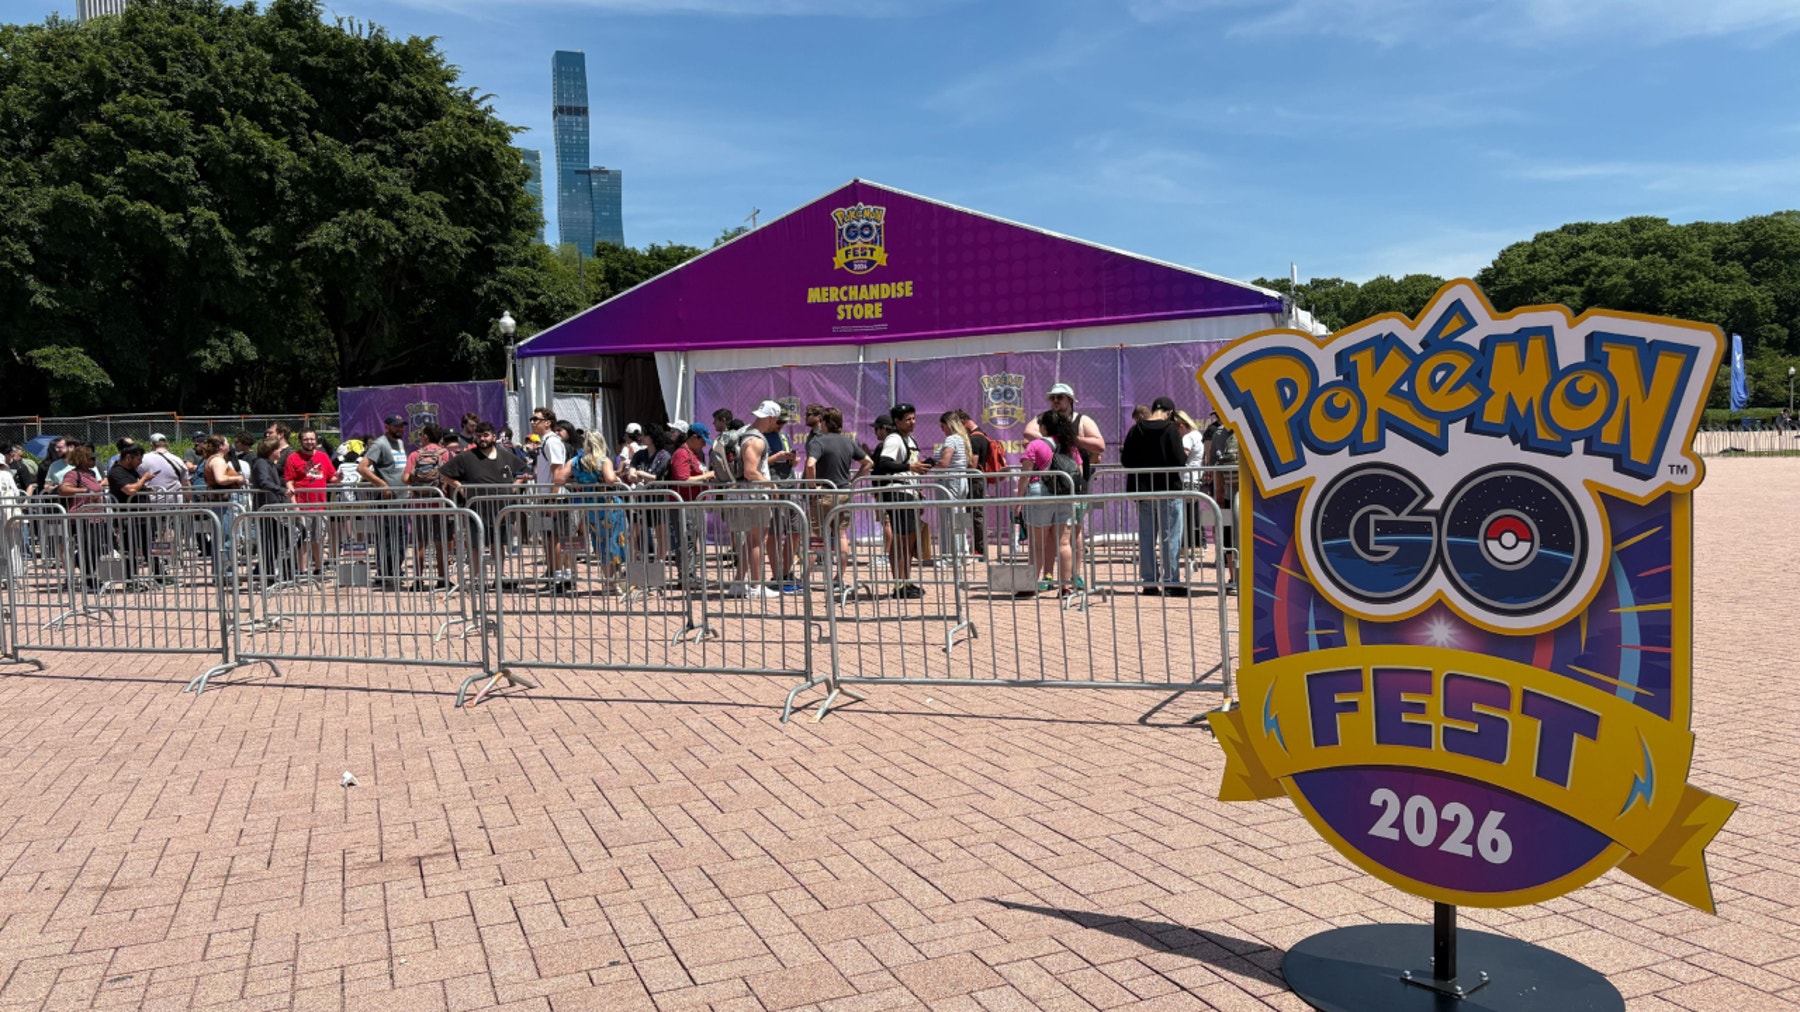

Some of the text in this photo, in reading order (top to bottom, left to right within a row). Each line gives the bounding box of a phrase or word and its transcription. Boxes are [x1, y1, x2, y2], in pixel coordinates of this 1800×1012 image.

[845, 222, 875, 240] GO
[845, 247, 876, 259] FEST
[807, 281, 913, 303] MERCHANDISE
[837, 302, 883, 320] STORE
[1311, 461, 1589, 617] GO
[1304, 665, 1603, 790] FEST
[1368, 787, 1513, 864] 2026
